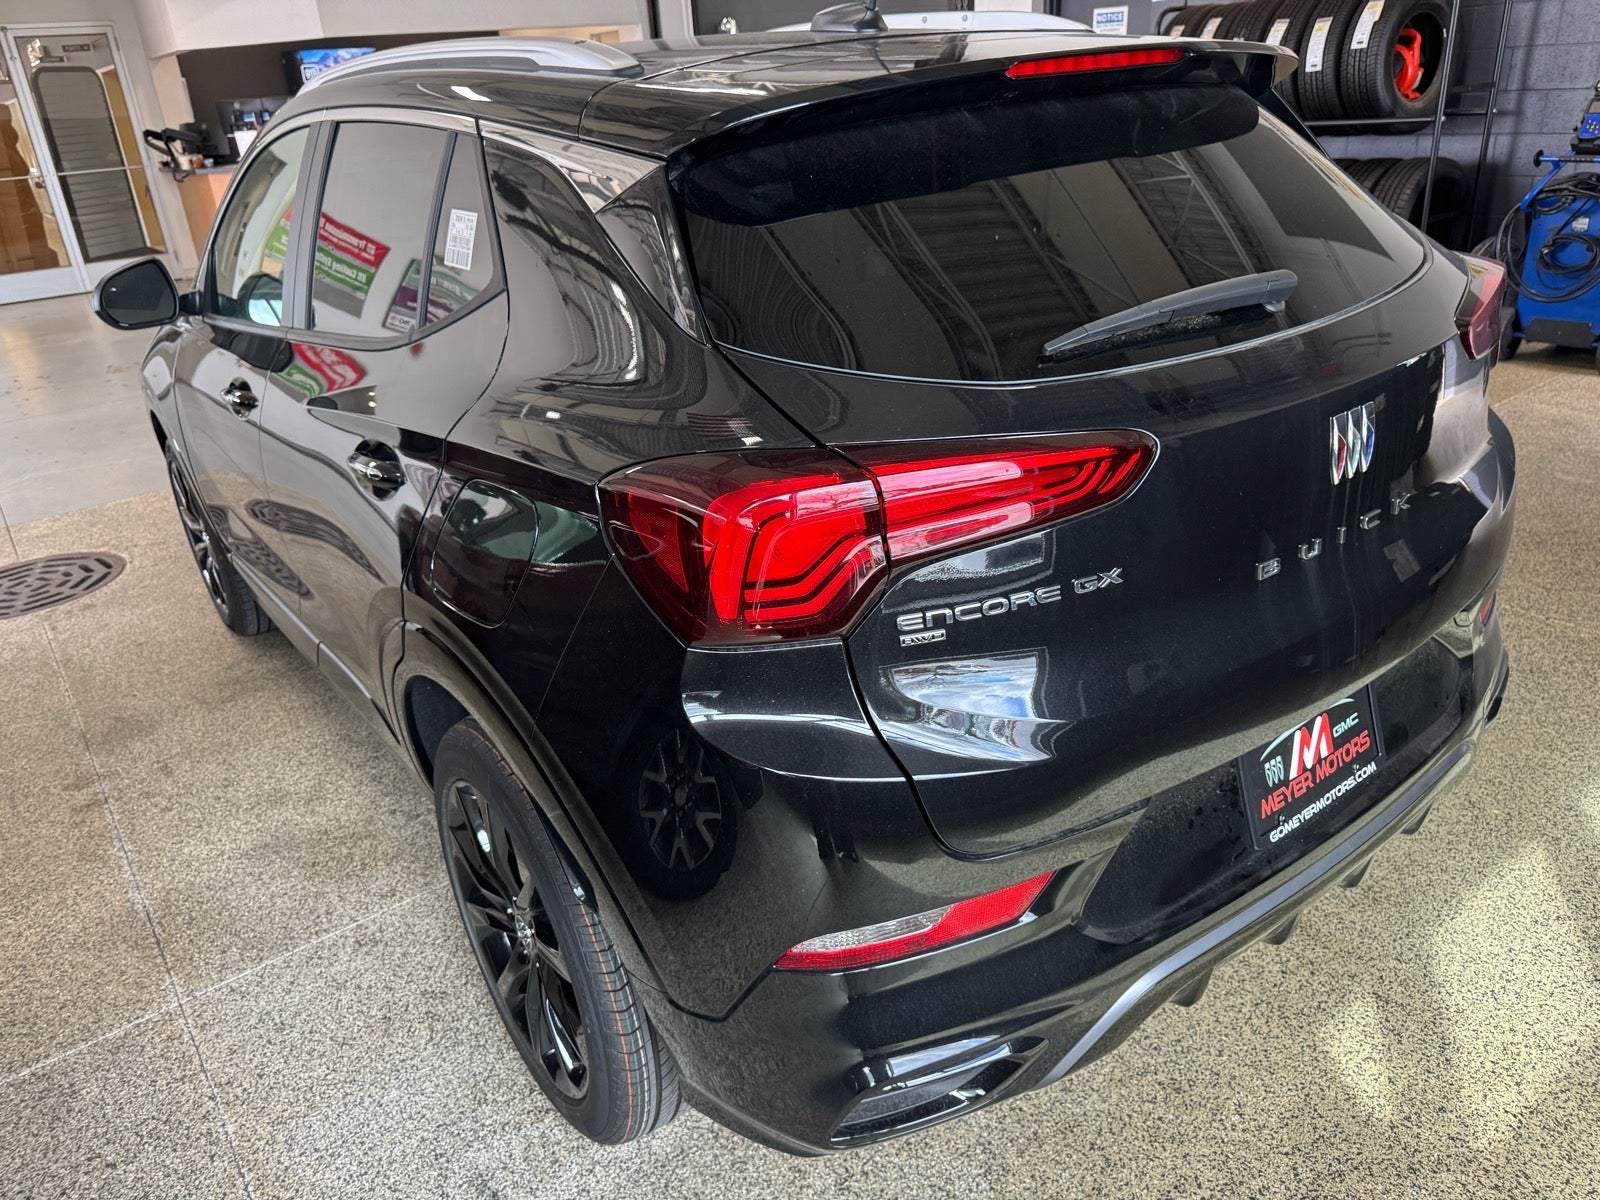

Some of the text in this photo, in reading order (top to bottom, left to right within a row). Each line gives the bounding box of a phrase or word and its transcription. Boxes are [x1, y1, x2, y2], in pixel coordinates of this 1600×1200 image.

[1096, 12, 1124, 22] NOTICE
[1255, 492, 1411, 581] BUICK
[896, 567, 1124, 631] ENCORE GX
[898, 628, 947, 648] AWD
[1333, 712, 1359, 738] GMC
[1260, 729, 1370, 819] MEYER MOTORS
[1269, 761, 1377, 843] GOMEYERMOTORS.COM
